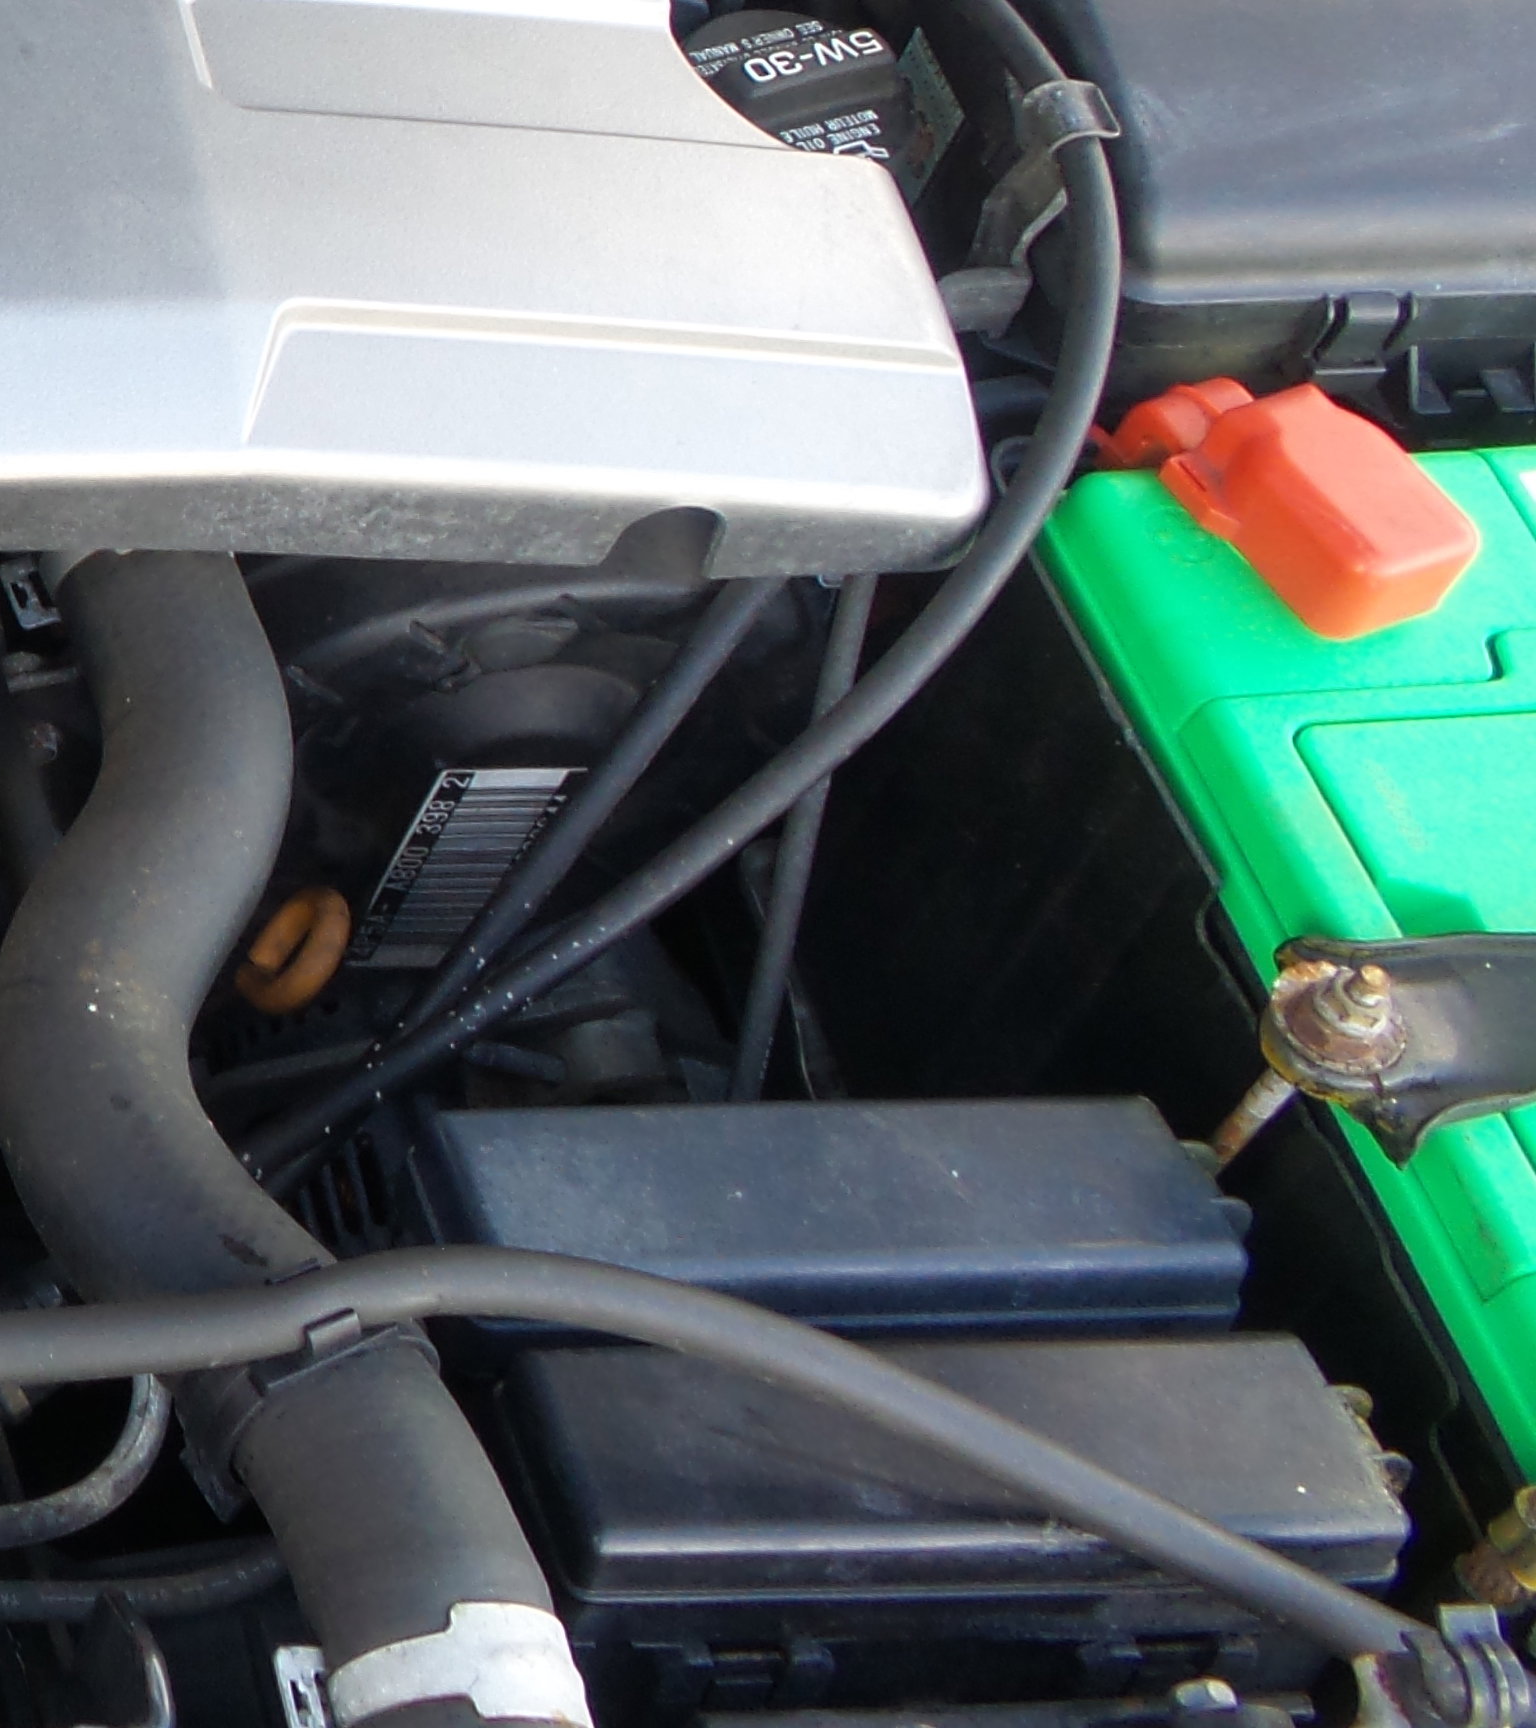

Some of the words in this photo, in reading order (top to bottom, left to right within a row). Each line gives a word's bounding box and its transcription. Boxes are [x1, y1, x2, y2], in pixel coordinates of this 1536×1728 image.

[741, 27, 795, 50] OWNER'S
[795, 20, 824, 36] SEE
[688, 42, 740, 63] MANUAL
[743, 30, 884, 83] 5W-30
[825, 109, 880, 130] MOTEUR
[779, 122, 825, 143] HUILE
[827, 122, 881, 146] ENGINE
[796, 137, 826, 152] OIL
[415, 799, 456, 835] 398
[441, 775, 470, 790] 2
